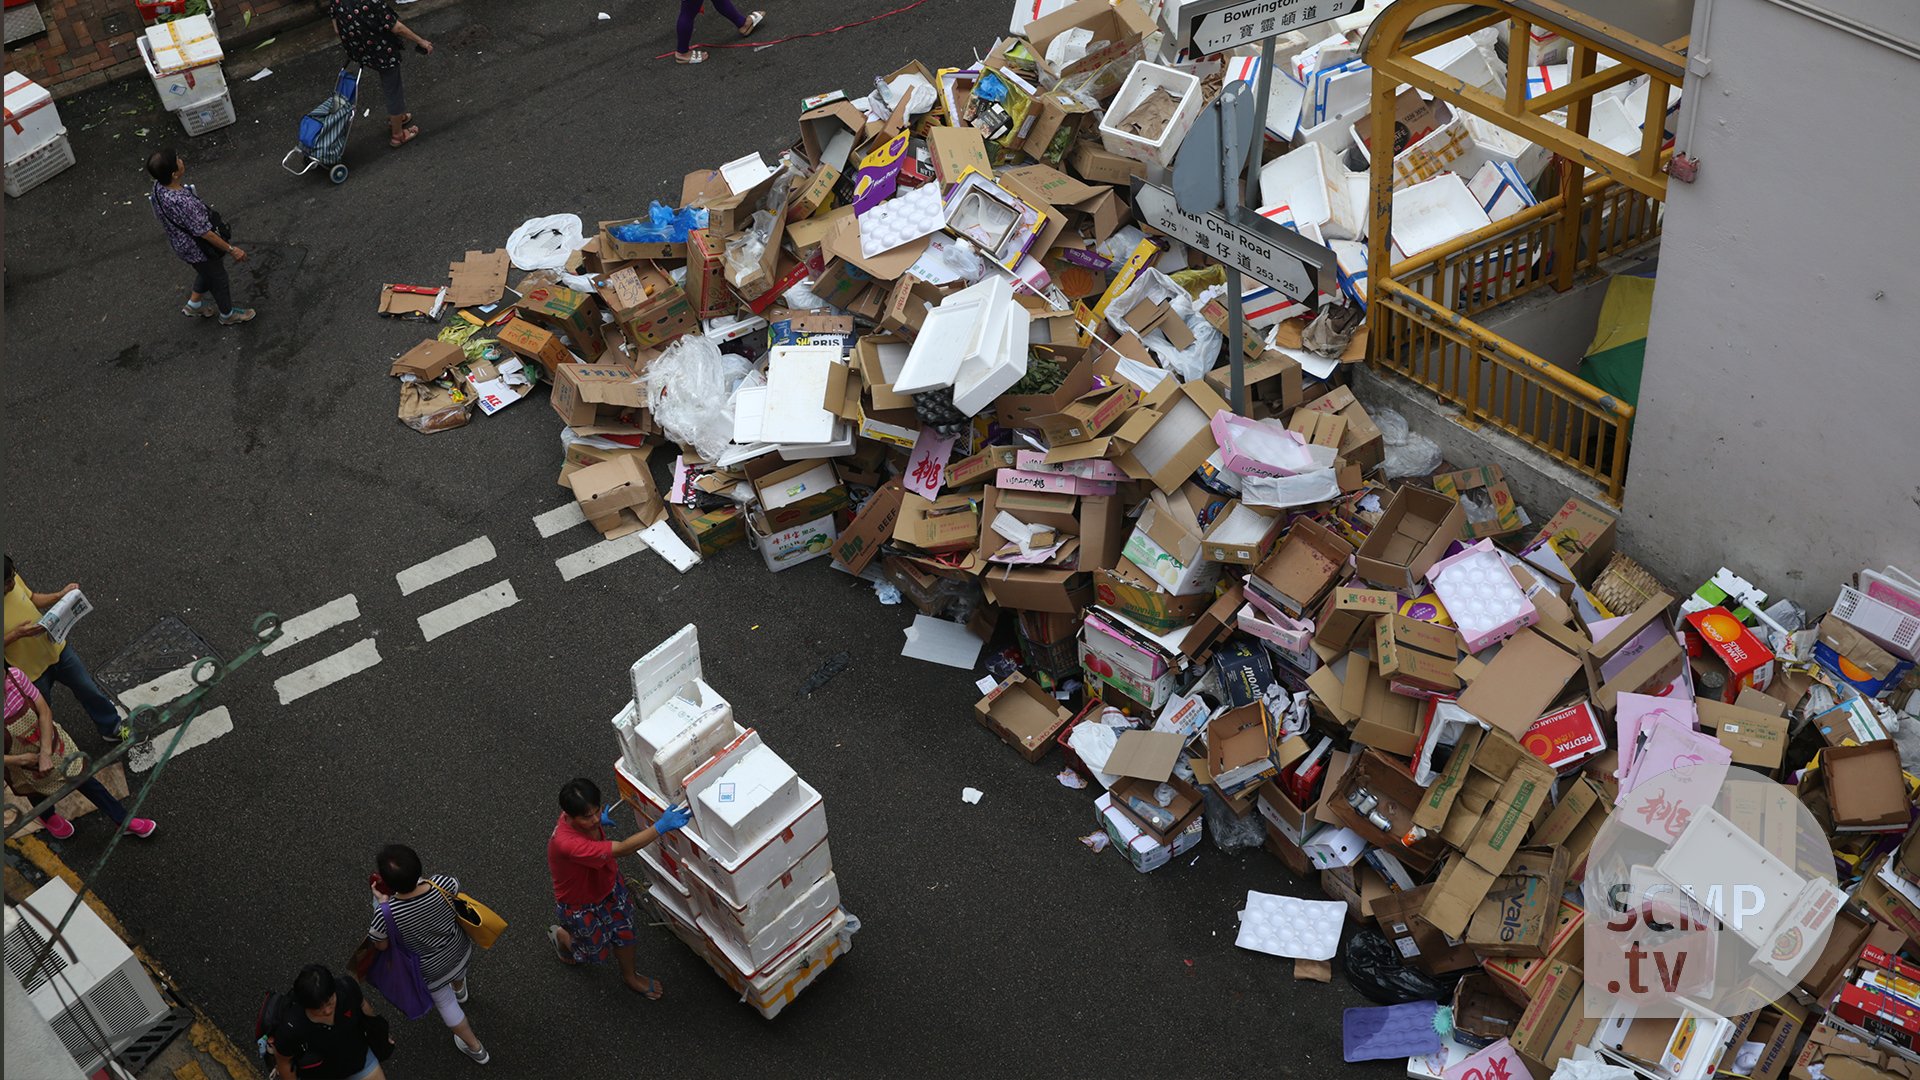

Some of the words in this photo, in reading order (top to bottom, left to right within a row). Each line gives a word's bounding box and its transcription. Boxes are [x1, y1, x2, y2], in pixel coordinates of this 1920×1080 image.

[1333, 2, 1344, 12] 21
[1240, 4, 1317, 40] 寶靈頓道
[1160, 217, 1178, 232] 275
[1176, 203, 1203, 226] Wan
[1206, 218, 1235, 242] Chai
[1239, 234, 1272, 260] Road
[1194, 230, 1253, 272] 灣仔道
[484, 391, 503, 409] ACE
[876, 507, 900, 532] BEEF
[1539, 707, 1577, 727] AUSTRALIAN
[1557, 732, 1594, 754] PEDTAK
[1491, 830, 1506, 847] KEEP
[1499, 808, 1519, 833] FROZEN
[1870, 1018, 1906, 1041] CHELAN
[1761, 1021, 1794, 1075] WATERMELON
